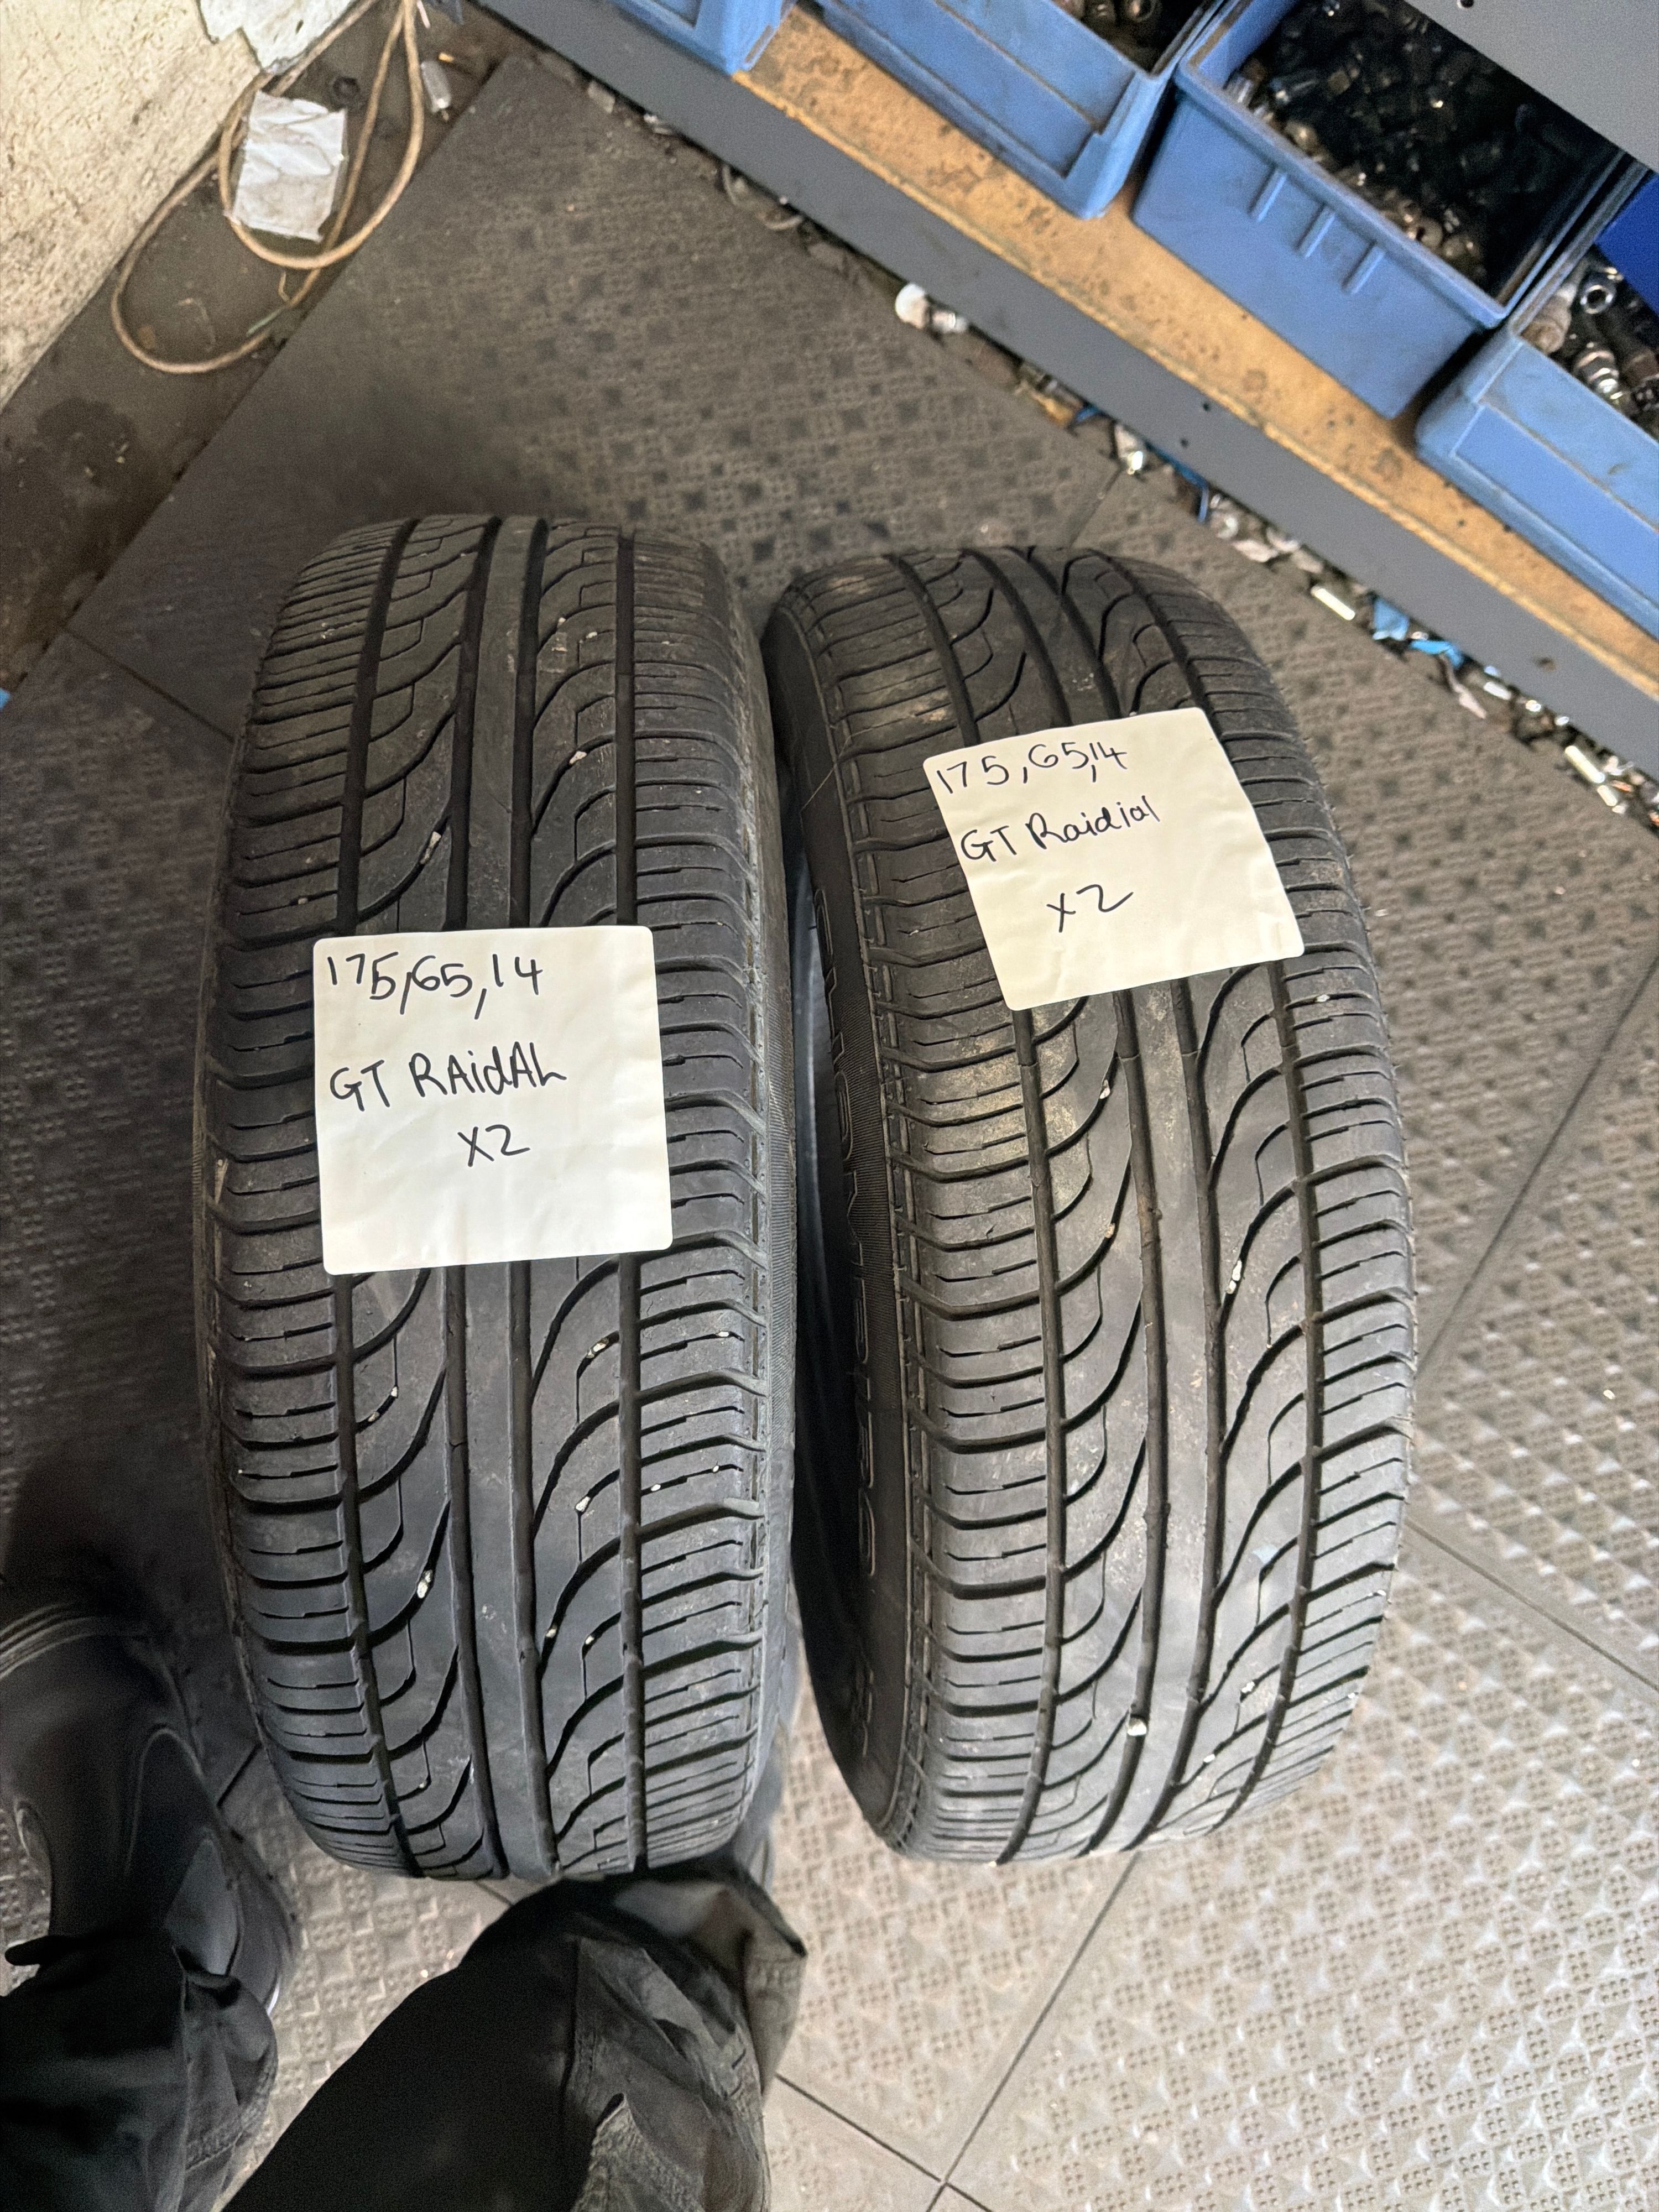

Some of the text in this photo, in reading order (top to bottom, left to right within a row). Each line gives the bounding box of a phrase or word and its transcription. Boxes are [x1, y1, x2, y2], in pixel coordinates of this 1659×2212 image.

[960, 795, 1161, 863] GT Raidial
[330, 1060, 391, 1112] GT
